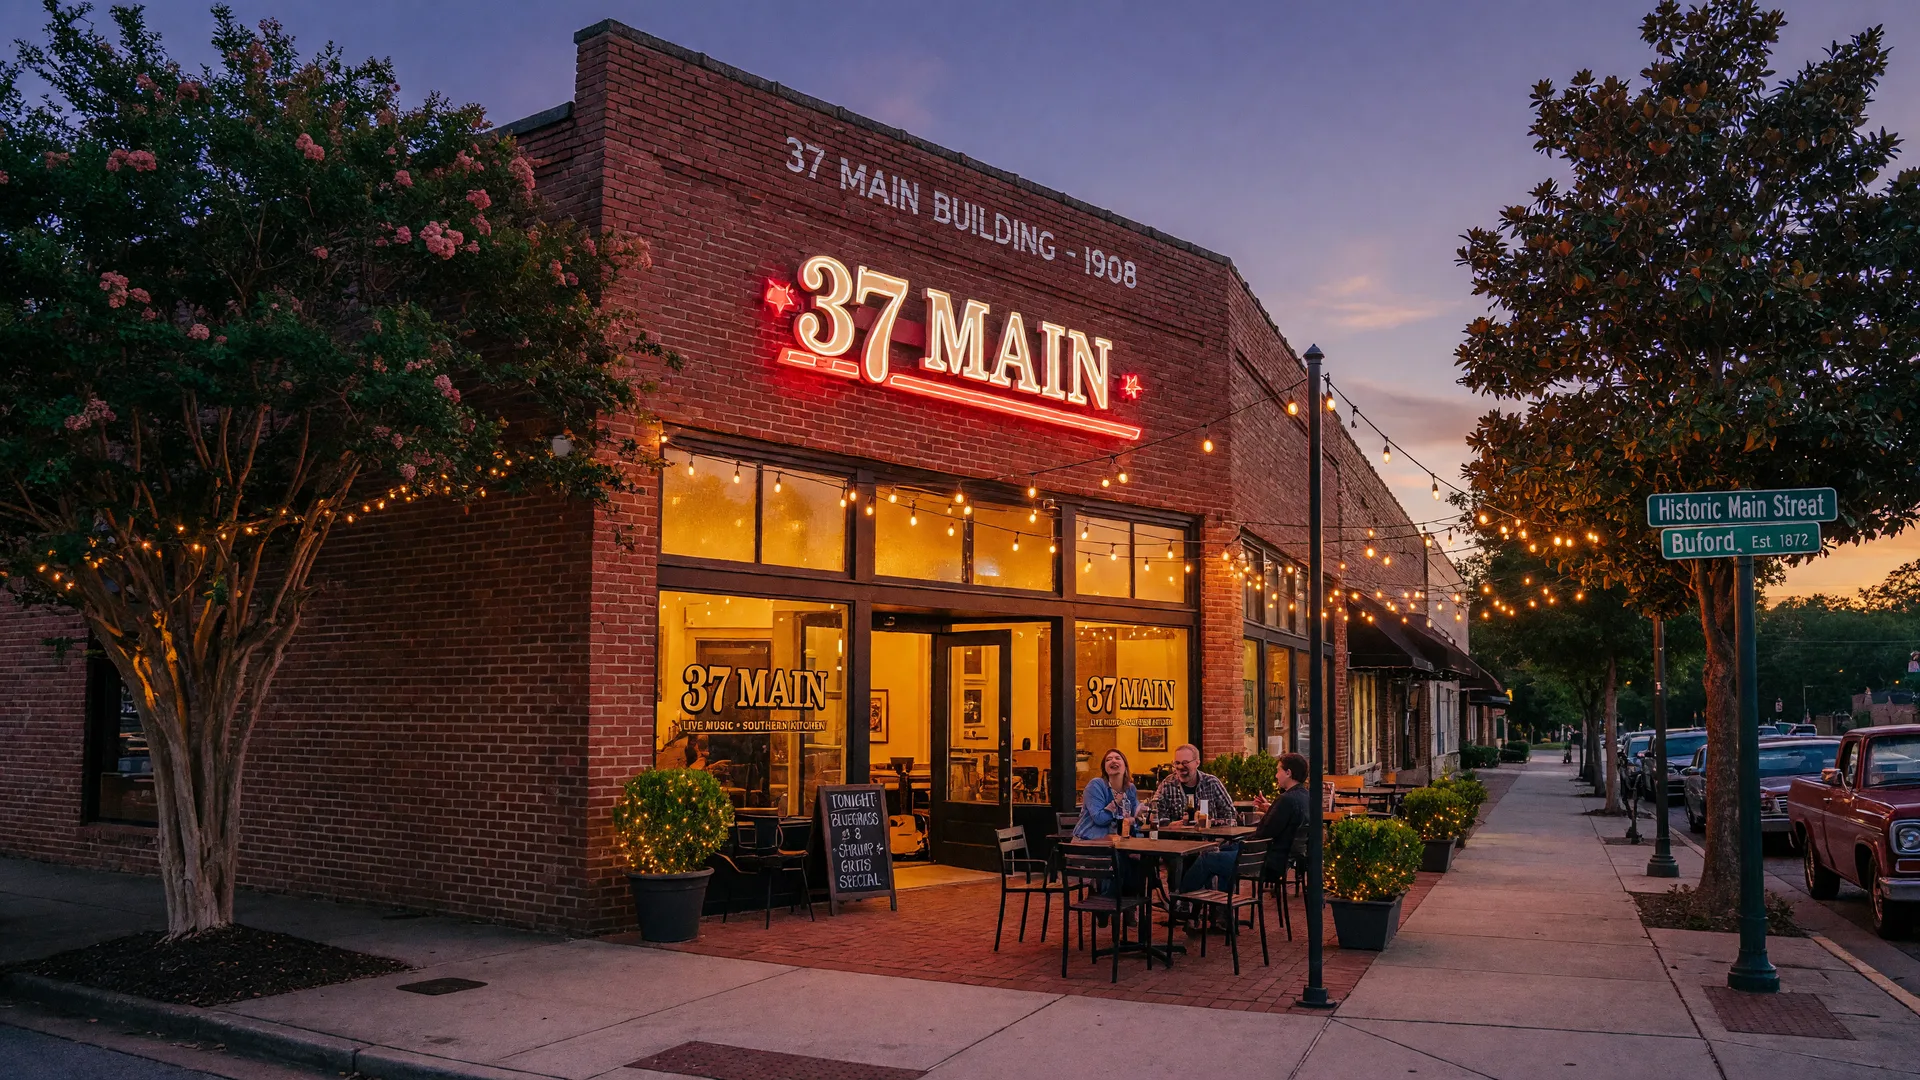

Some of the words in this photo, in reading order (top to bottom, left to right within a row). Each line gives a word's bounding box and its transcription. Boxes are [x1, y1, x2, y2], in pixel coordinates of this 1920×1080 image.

[786, 136, 825, 179] 37
[840, 157, 920, 215] MAIN
[934, 191, 1056, 261] BUILDING
[1084, 246, 1138, 290] 1908
[794, 255, 909, 385] 37
[919, 287, 1113, 411] MAIN
[1659, 496, 1721, 521] Historic
[1728, 494, 1767, 519] Main
[1773, 493, 1825, 517] Streat
[1779, 533, 1809, 548] 1872
[681, 663, 732, 716] 37
[735, 667, 829, 711] MAIN
[1086, 675, 1118, 715] 37
[1120, 677, 1176, 711] MAIN
[683, 720, 703, 731] LIVE
[705, 720, 734, 731] MUSIC
[742, 720, 787, 731] SOUTHERN
[830, 811, 879, 827] BLUEGRASS
